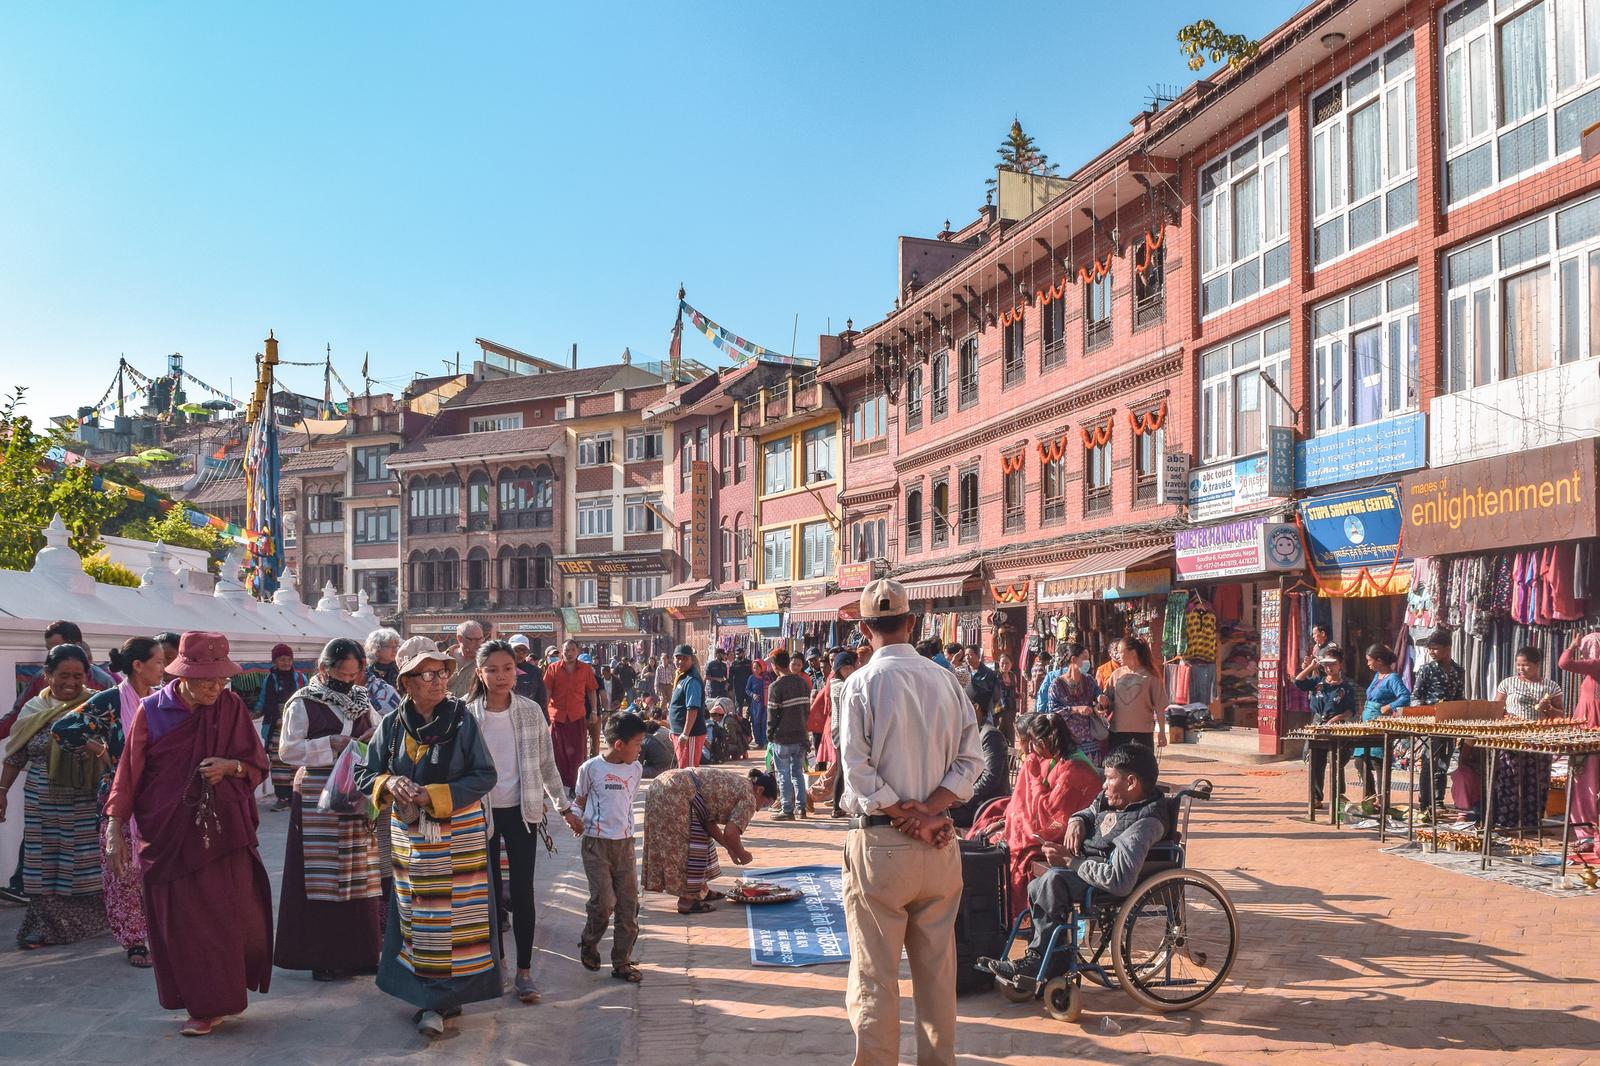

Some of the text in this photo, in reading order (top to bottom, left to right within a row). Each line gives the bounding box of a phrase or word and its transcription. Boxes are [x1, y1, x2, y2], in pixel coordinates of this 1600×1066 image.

[1347, 433, 1373, 446] Book
[1376, 427, 1412, 439] Center
[1167, 454, 1185, 463] abc
[1166, 464, 1185, 472] tours
[1202, 468, 1232, 482] abc tours
[1165, 480, 1187, 488] travels
[1202, 484, 1208, 493] &
[1208, 480, 1232, 492] travels
[1410, 476, 1448, 496] images of
[1411, 468, 1582, 529] enlightenment
[1308, 505, 1330, 520] STUPA
[1330, 499, 1366, 517] SHOPPING
[1366, 494, 1395, 512] CENTRE
[695, 473, 706, 557] THANGKA
[557, 560, 595, 574] TIBET
[598, 563, 630, 573] HOUSE
[579, 614, 600, 624] TIBET
